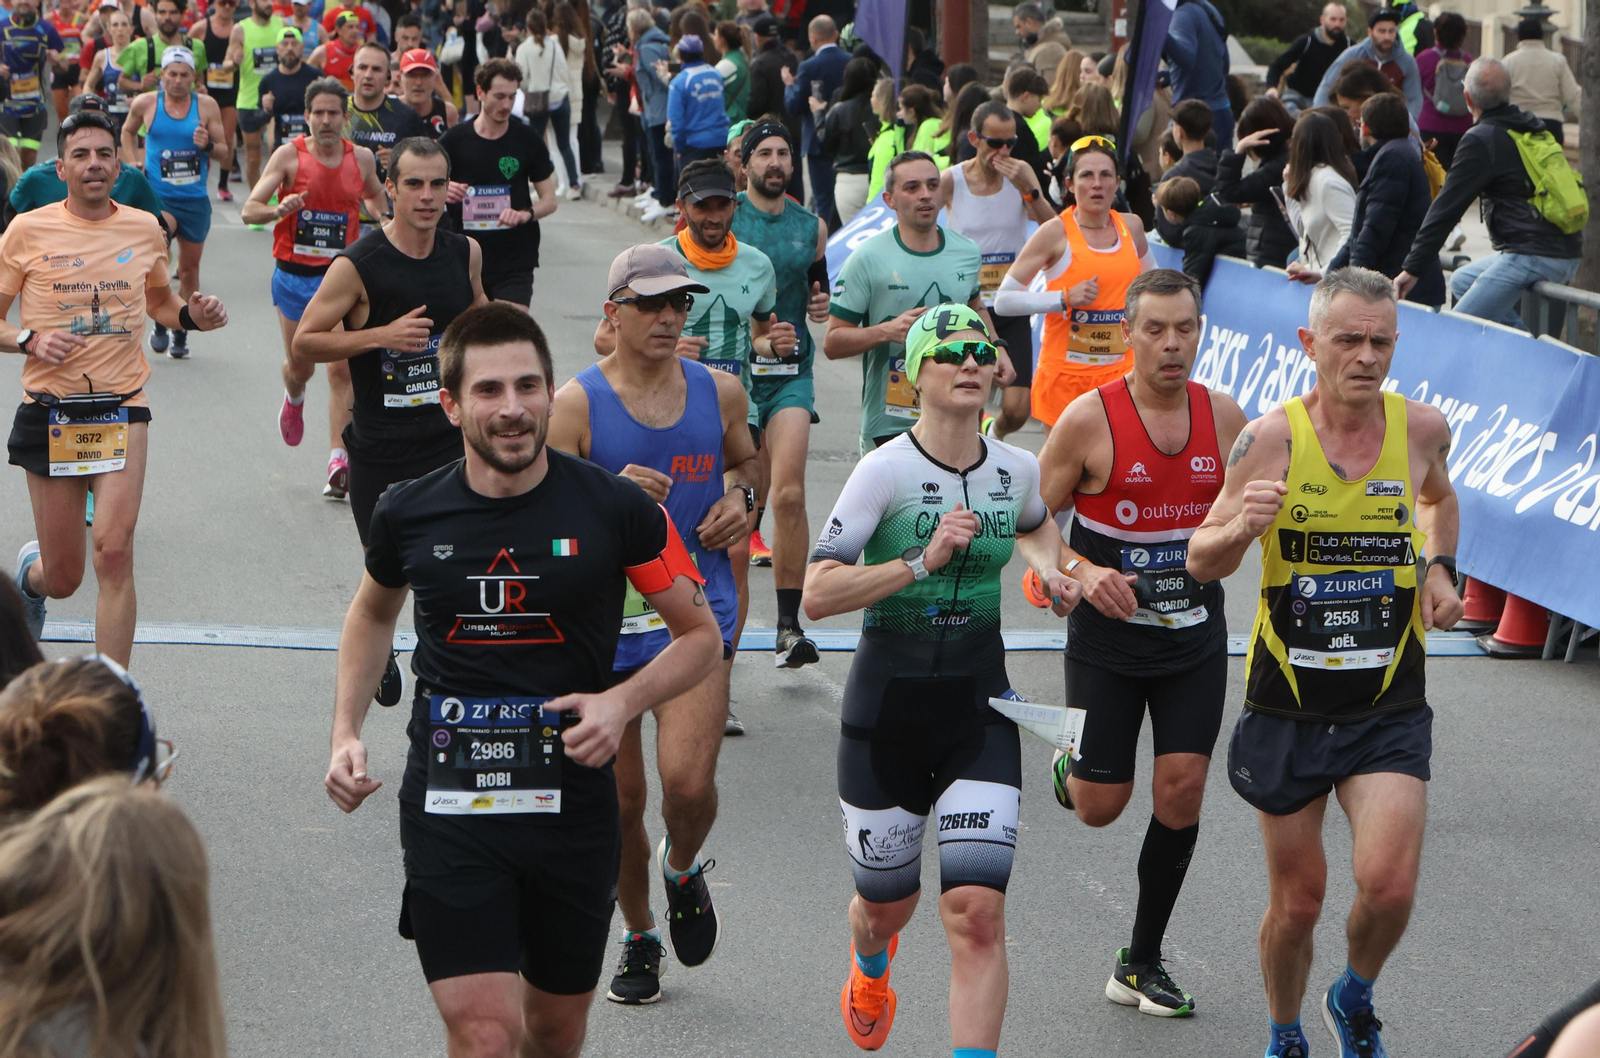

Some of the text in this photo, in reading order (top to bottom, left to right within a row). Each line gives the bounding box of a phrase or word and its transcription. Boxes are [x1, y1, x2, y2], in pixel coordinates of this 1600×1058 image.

[315, 212, 344, 222] ZURICH
[53, 282, 92, 291] Maratón
[99, 280, 130, 290] Sevilla
[1092, 312, 1124, 322] ZURICH
[1090, 332, 1111, 340] 4462
[408, 362, 432, 376] 2540
[406, 380, 438, 393] CARLOS
[76, 433, 102, 444] 3672
[77, 451, 102, 460] DAVID
[1464, 418, 1558, 498] asics
[670, 454, 714, 474] RUN
[1373, 484, 1404, 494] quevilly
[1142, 502, 1212, 520] outsystem
[1311, 536, 1339, 548] Club
[1156, 550, 1186, 562] ZURI
[1156, 577, 1184, 592] 3056
[1324, 577, 1382, 592] ZURICH
[480, 581, 526, 614] UR
[1150, 598, 1189, 612] RICARDO
[1324, 610, 1359, 626] 2558
[1328, 633, 1358, 649] JOËL
[471, 742, 515, 760] 2986
[476, 772, 511, 788] ROBI
[940, 812, 990, 832] 226ERS
